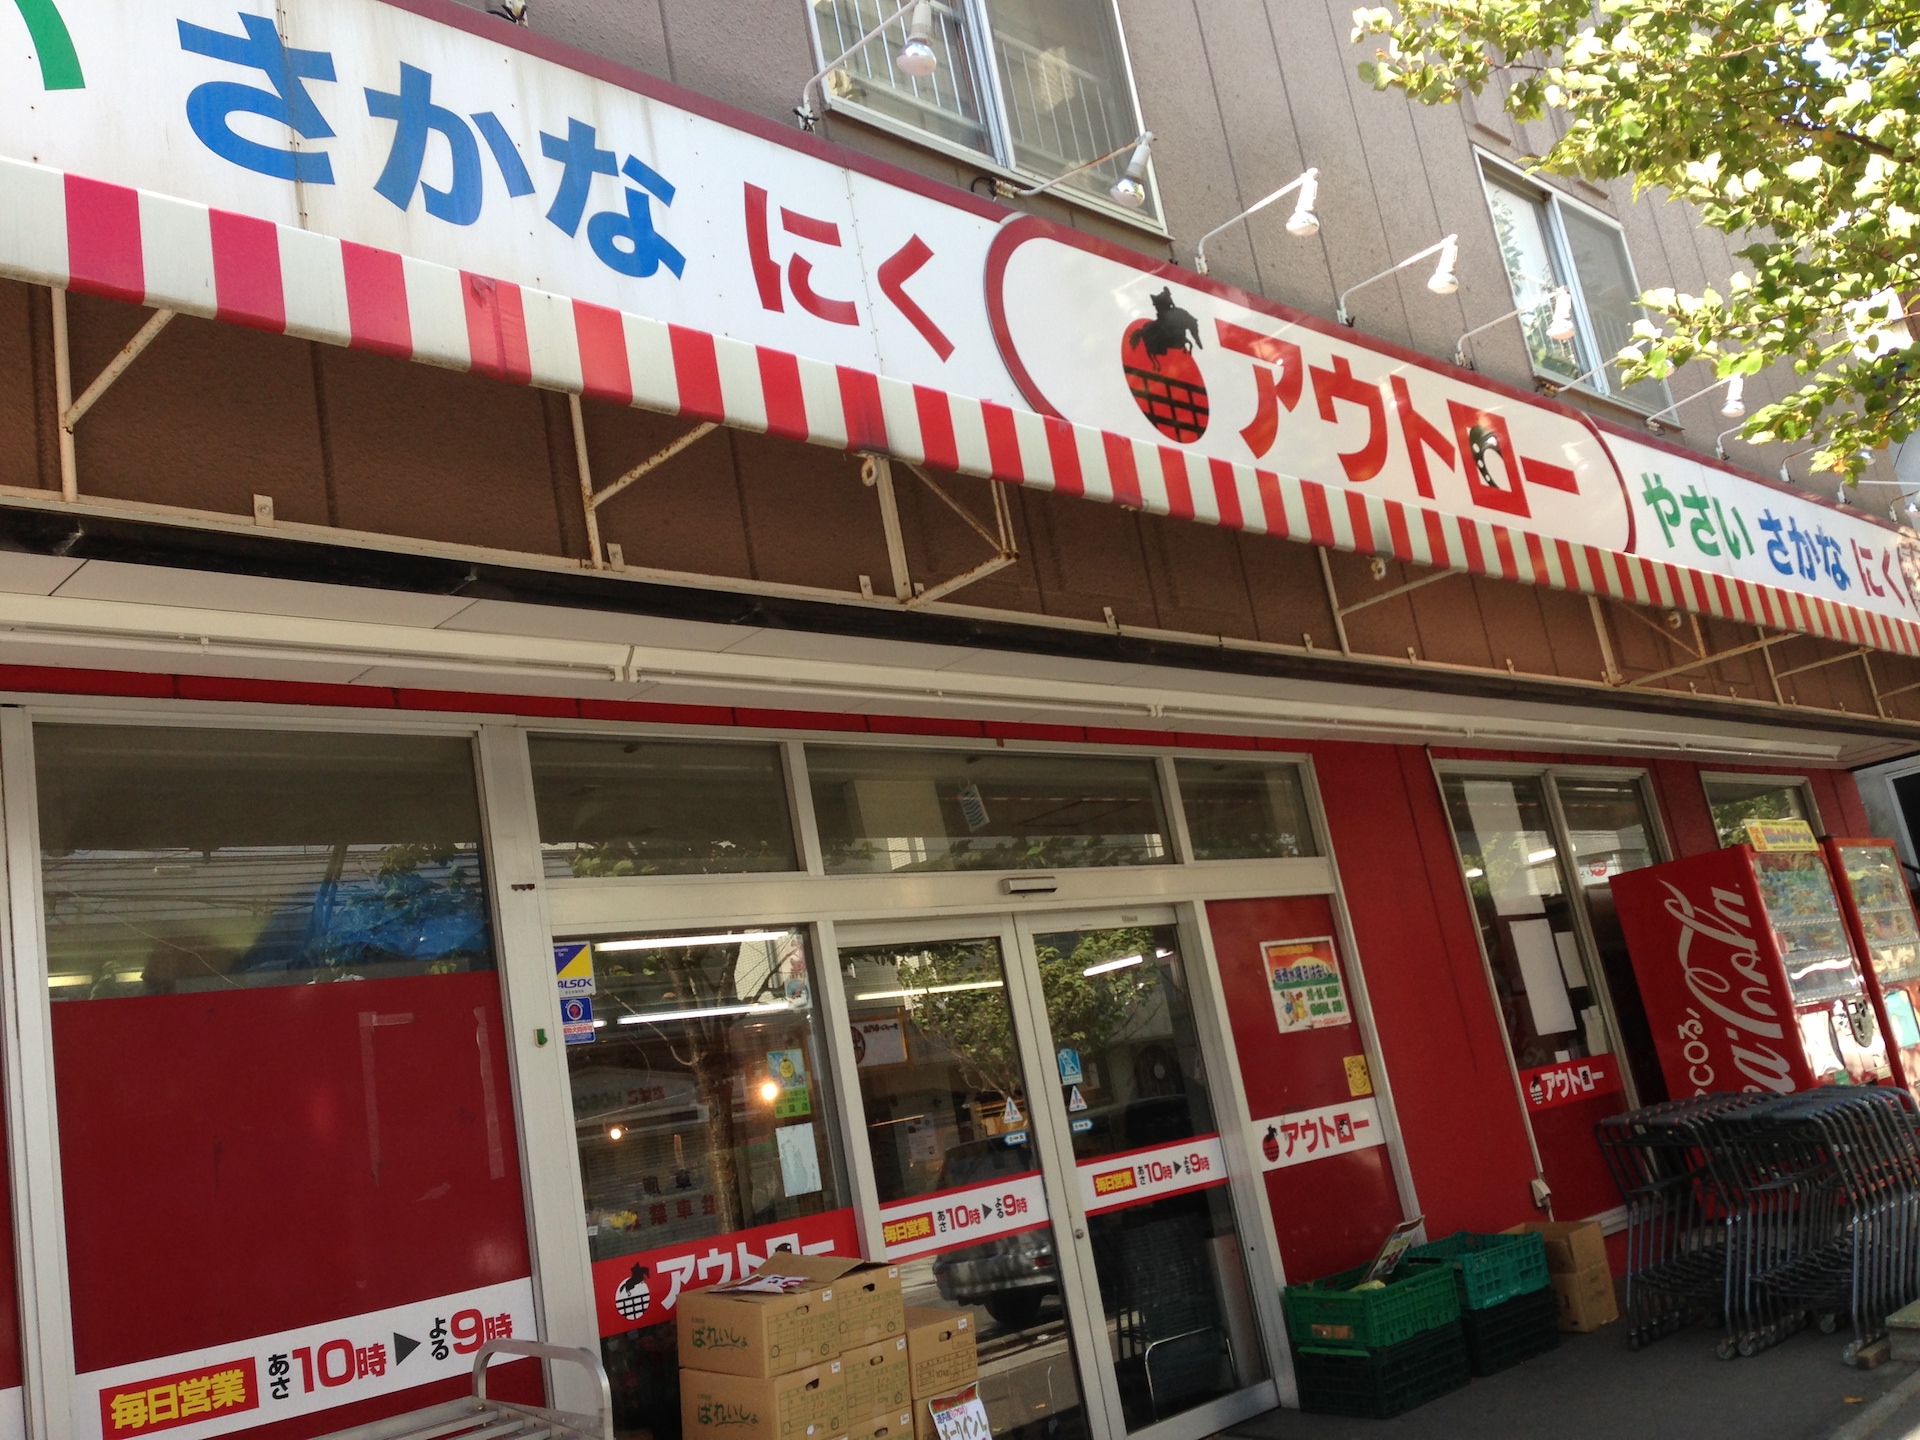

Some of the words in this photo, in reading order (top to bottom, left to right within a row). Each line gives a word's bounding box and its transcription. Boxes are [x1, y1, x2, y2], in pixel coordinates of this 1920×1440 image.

[176, 11, 687, 280] さかな
[744, 181, 955, 362] にく
[1214, 318, 1580, 518] アウトロー
[1641, 472, 1755, 560] やさい
[1757, 509, 1851, 591] さかな
[1850, 537, 1905, 608] にく
[1541, 1065, 1604, 1101] アウトロー
[1280, 1113, 1370, 1158] アウトロー
[1095, 1170, 1134, 1193] 毎日営業
[883, 1214, 931, 1243] 毎日営業
[110, 1369, 246, 1430] 毎日営業
